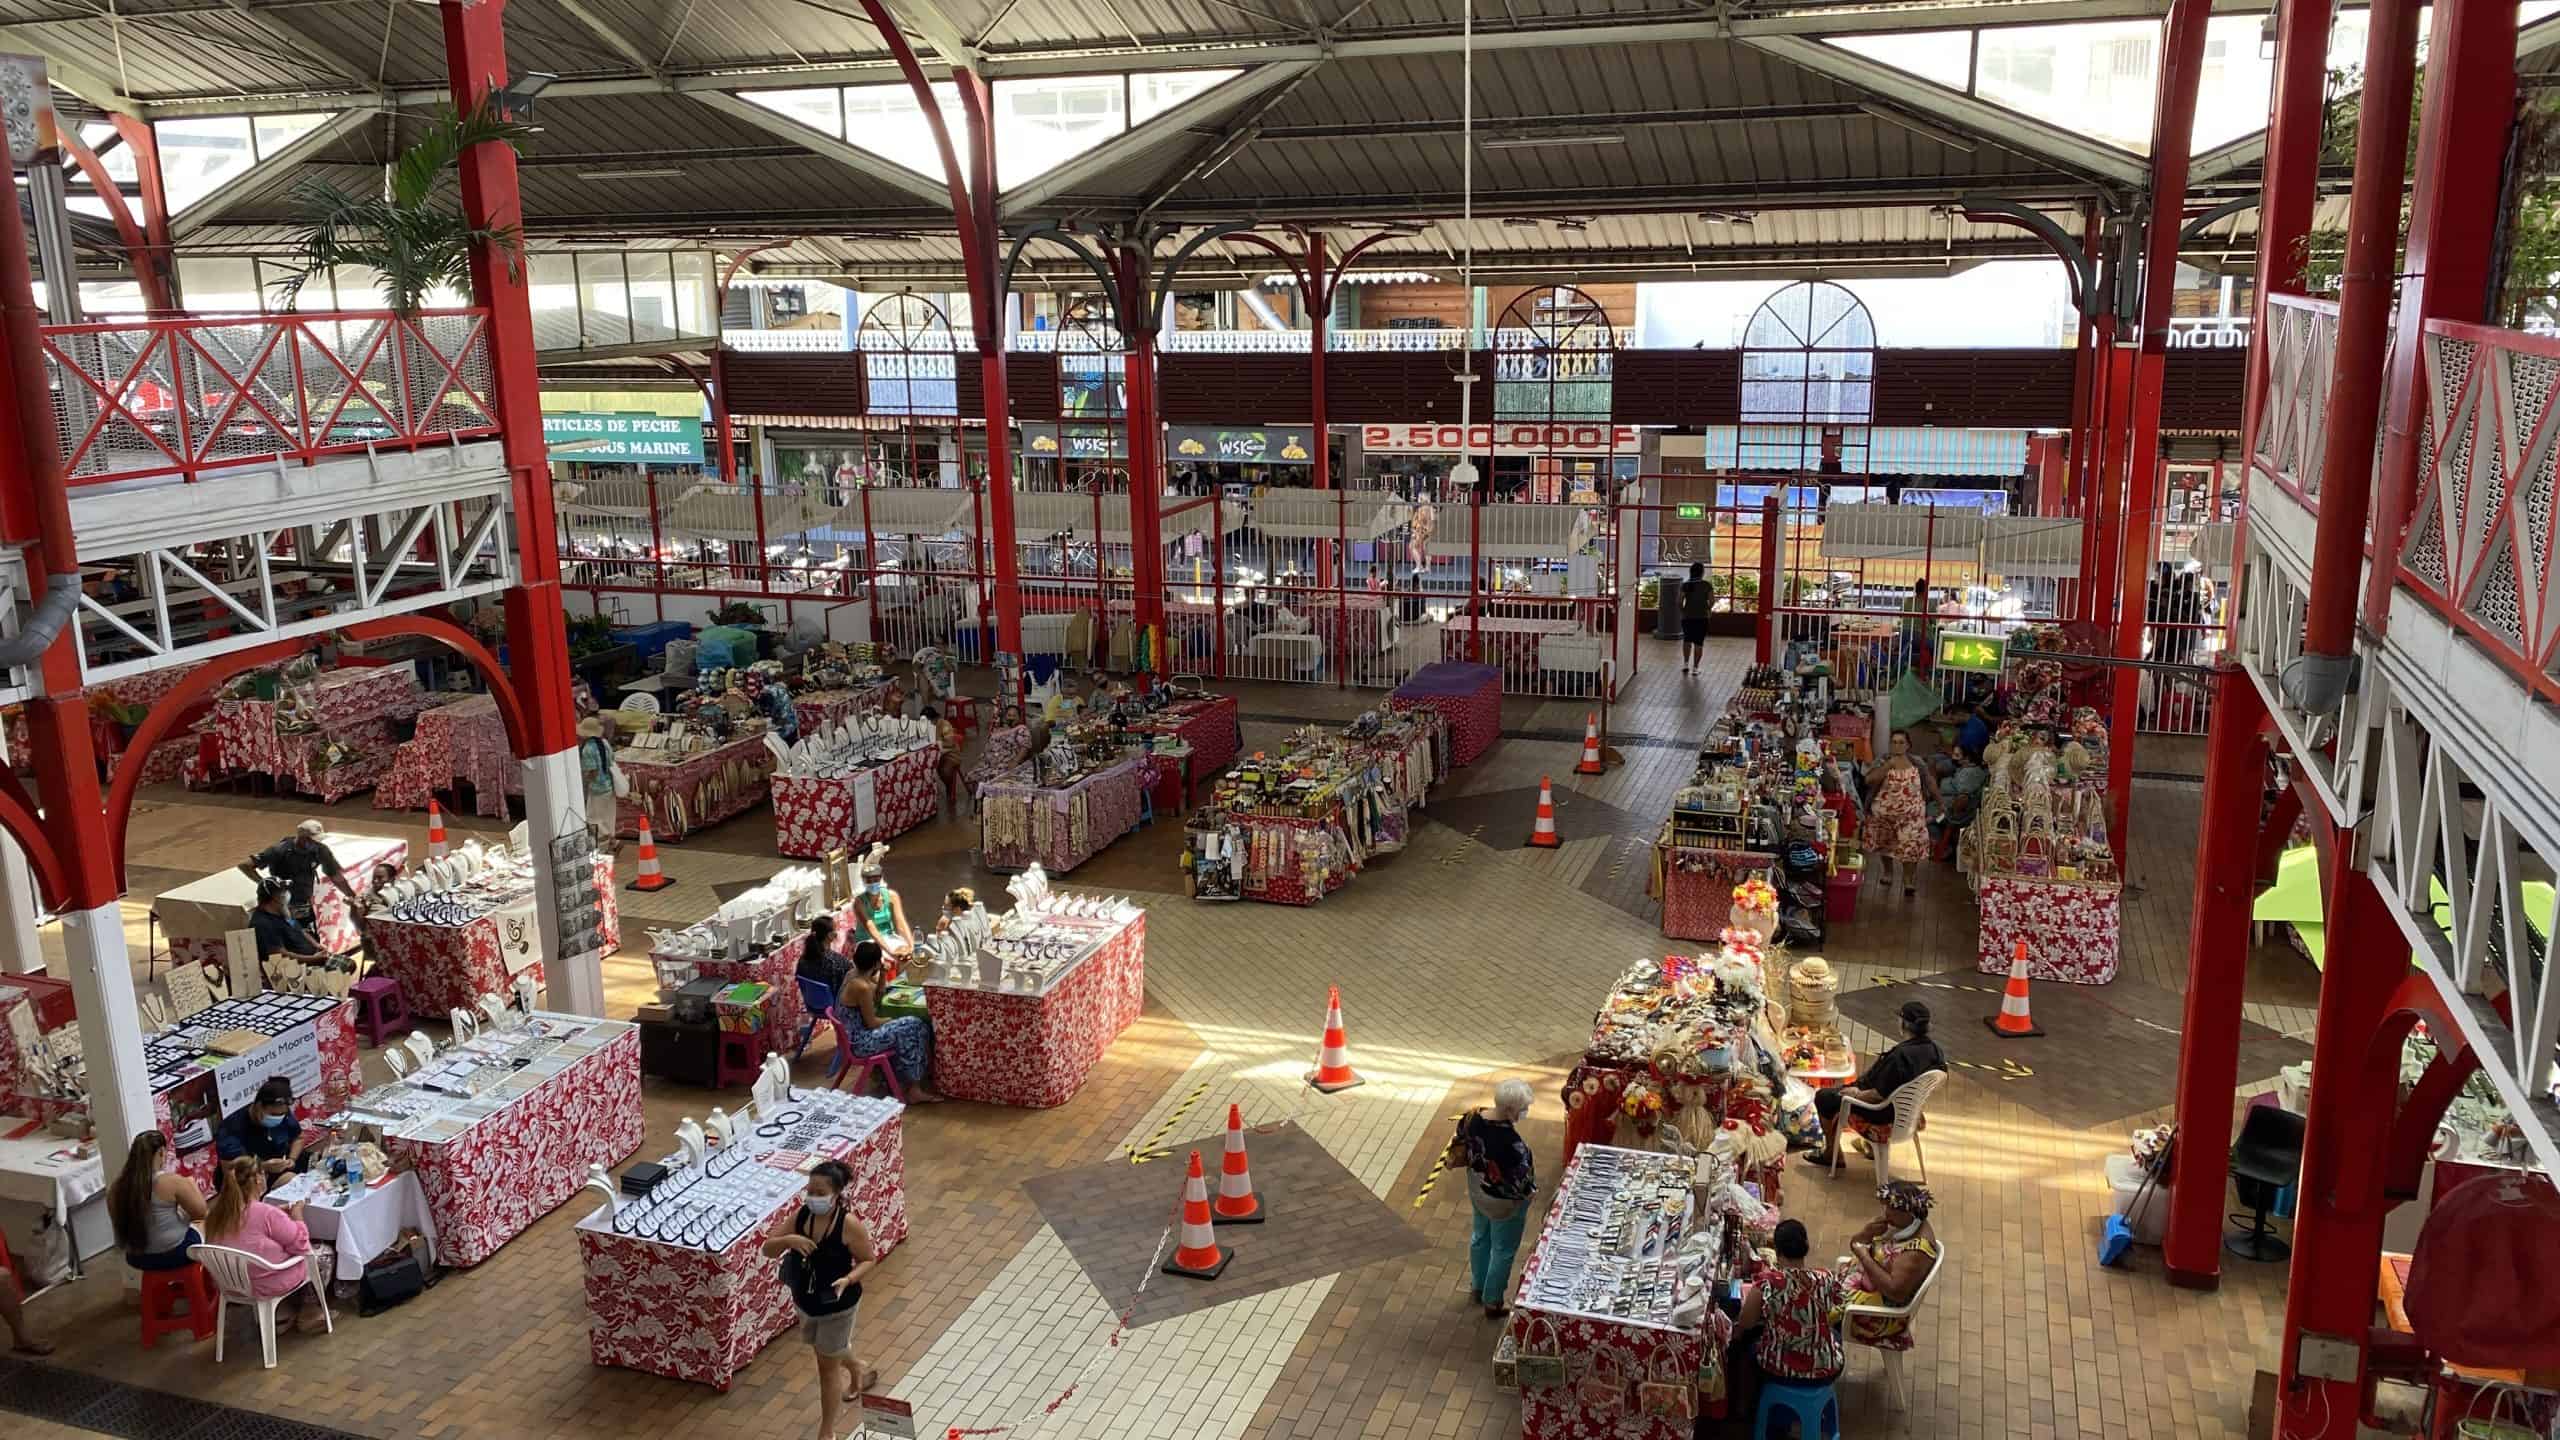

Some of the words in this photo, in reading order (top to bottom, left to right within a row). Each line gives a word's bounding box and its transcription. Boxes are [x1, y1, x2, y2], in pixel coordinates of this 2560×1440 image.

[542, 418, 602, 431] RTICLES
[607, 419, 628, 432] DE
[632, 419, 681, 432] PECHE
[630, 441, 690, 455] MARINE
[1072, 437, 1106, 452] WSK
[1219, 439, 1254, 456] WSK
[220, 1065, 246, 1084] Fetia
[247, 1050, 277, 1072] Pearls
[278, 1031, 316, 1055] Moorea
